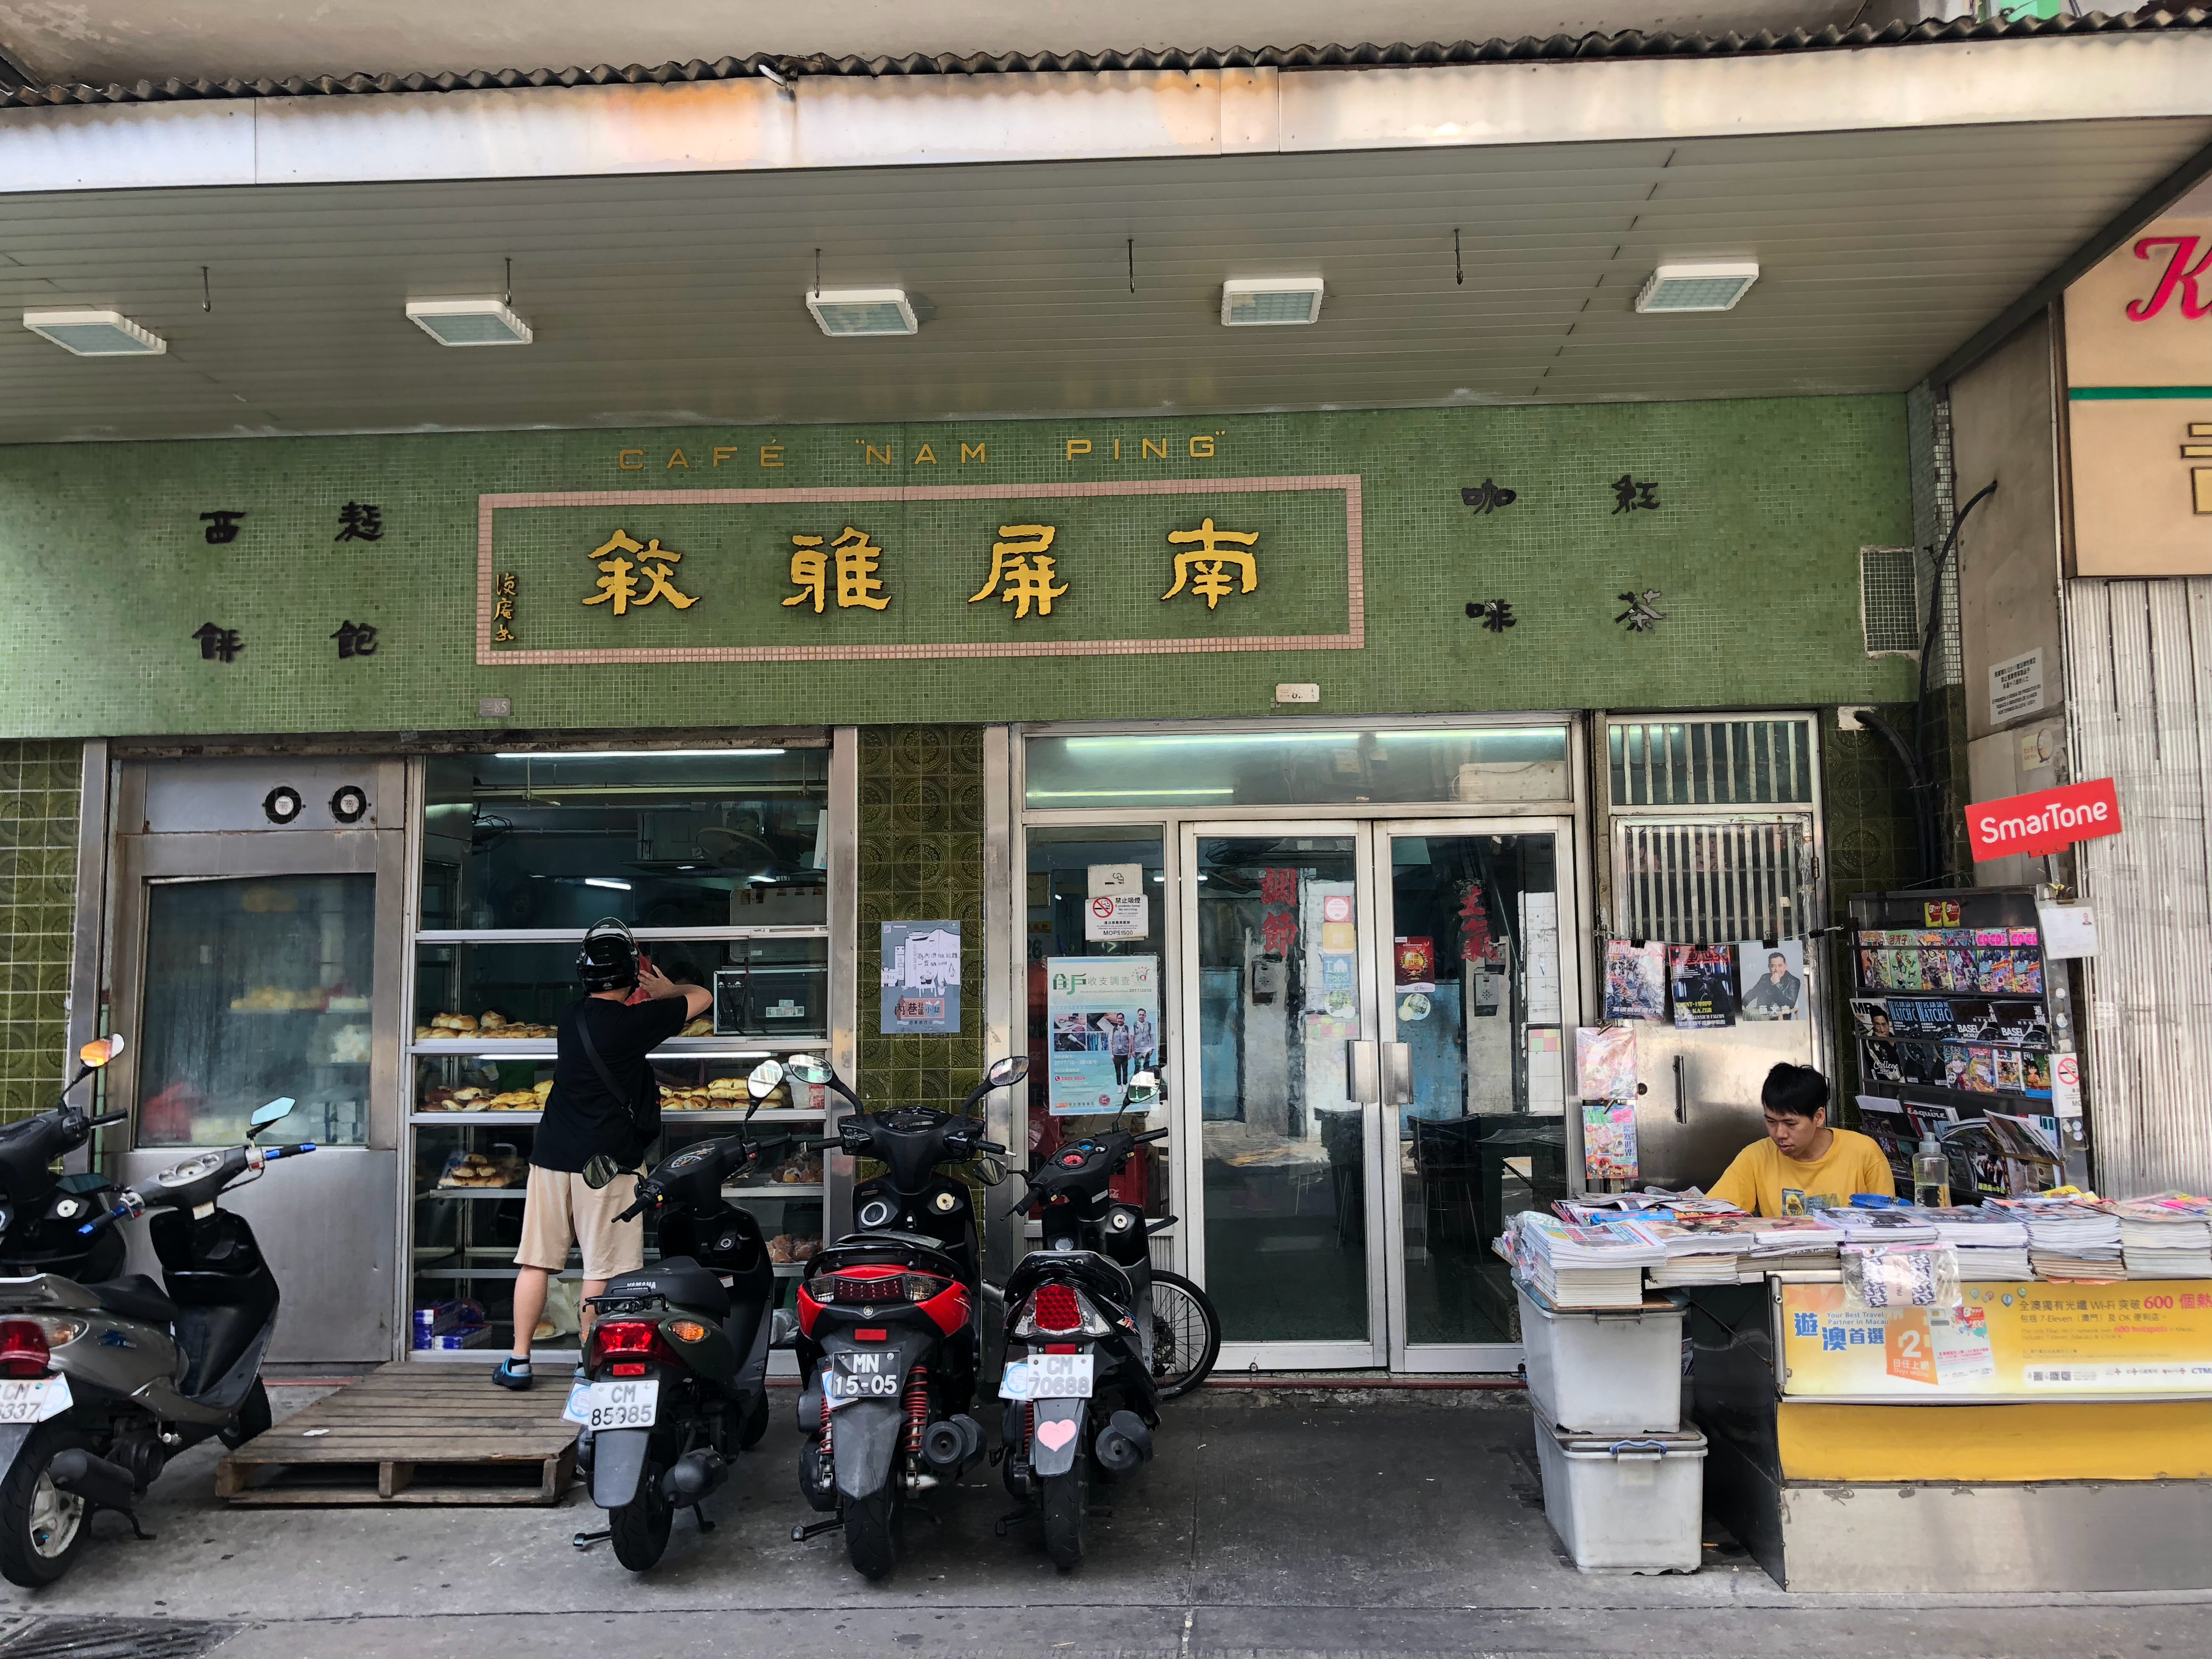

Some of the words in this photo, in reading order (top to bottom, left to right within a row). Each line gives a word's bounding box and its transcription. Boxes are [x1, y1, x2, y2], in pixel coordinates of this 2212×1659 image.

[619, 439, 785, 470] CAFÉ
[1979, 800, 2108, 843] SmarTone
[1257, 867, 1298, 957] 調節
[1325, 974, 1348, 982] Food
[1957, 1024, 1979, 1033] BASEL
[2001, 1028, 2025, 1036] BASEL
[1906, 1107, 1946, 1119] Esquire
[2090, 1301, 2115, 1310] Wi-Fi
[2119, 1299, 2141, 1310] 突破
[2144, 1296, 2173, 1309] 600
[1901, 1330, 1921, 1357] 2
[853, 1353, 879, 1373] MN
[1047, 1357, 1073, 1375] CM
[3, 1382, 31, 1400] CM
[611, 1384, 636, 1403] CM
[835, 1374, 898, 1395] 15-05
[1029, 1376, 1090, 1396] 70688
